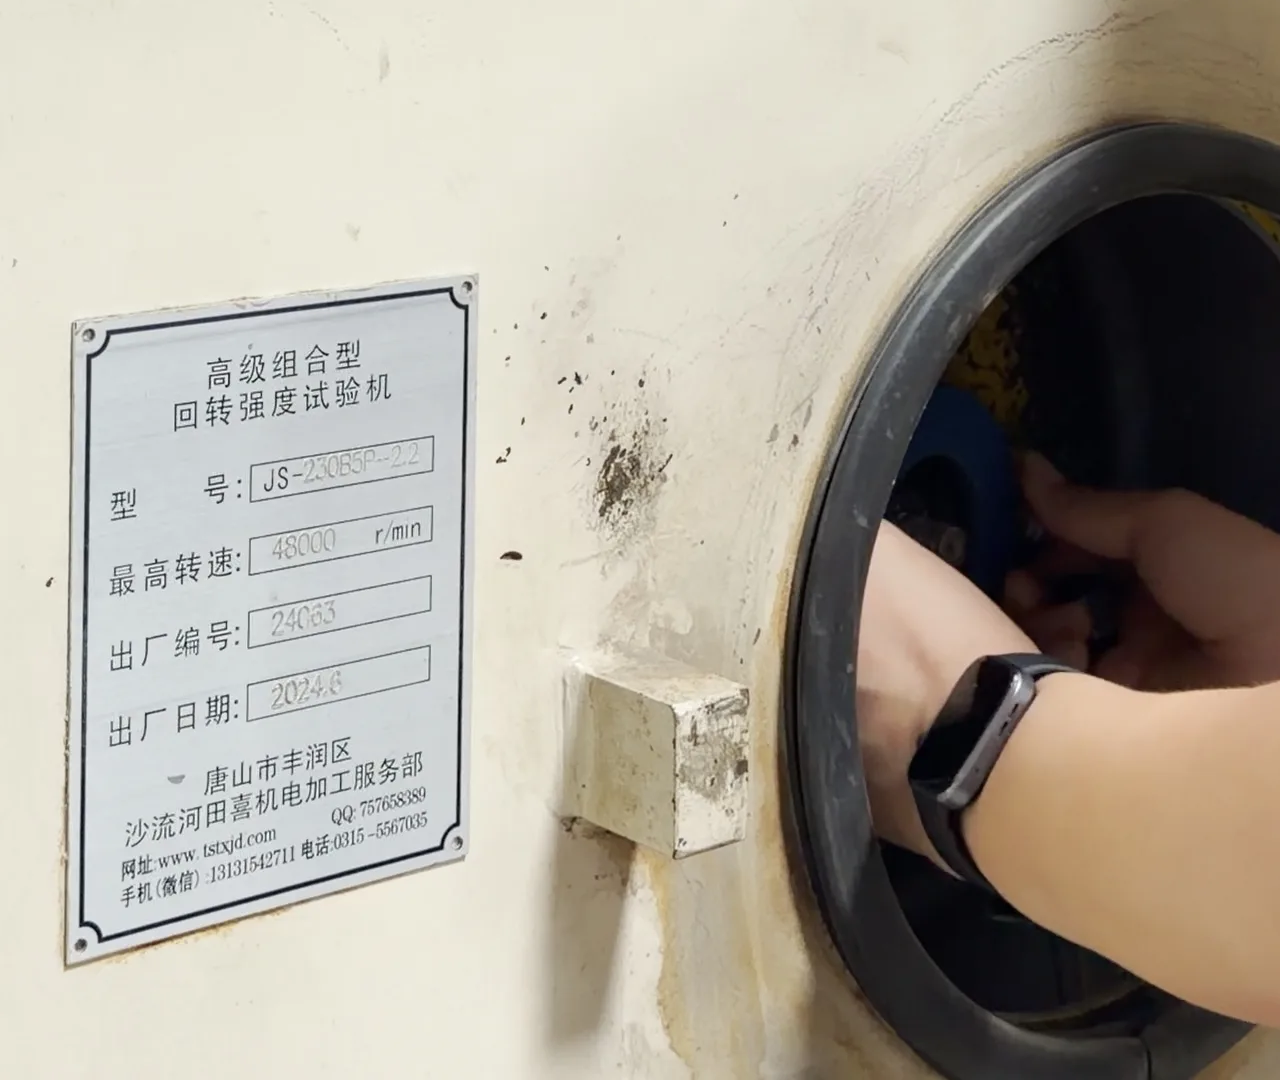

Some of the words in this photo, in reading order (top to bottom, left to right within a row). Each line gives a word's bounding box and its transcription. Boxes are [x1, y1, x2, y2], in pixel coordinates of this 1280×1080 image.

[207, 339, 362, 390] 高级组合型
[173, 373, 392, 432] 回转强度试验机
[108, 546, 242, 597] 最高转速：
[272, 527, 336, 560] 48000
[375, 519, 421, 545] r/min
[109, 619, 241, 672] 出厂编号：
[108, 694, 240, 748] 出厂日期：
[204, 737, 353, 796] 唐山市丰润区
[125, 751, 424, 848] 沙流河田喜机电加工服务部
